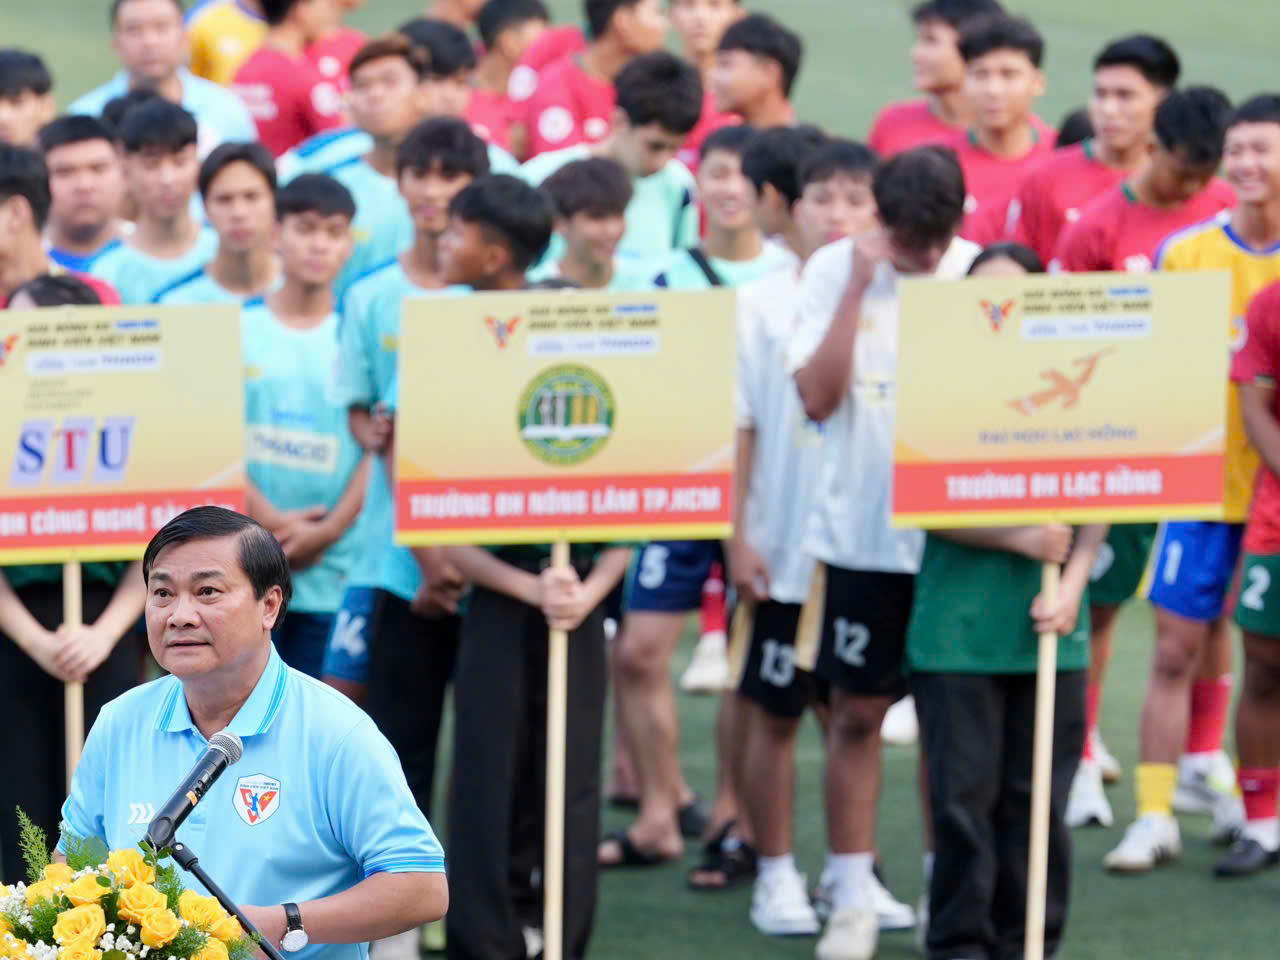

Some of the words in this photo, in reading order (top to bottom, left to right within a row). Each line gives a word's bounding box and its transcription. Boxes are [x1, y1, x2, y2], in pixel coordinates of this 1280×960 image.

[19, 427, 131, 475] STU
[1239, 564, 1271, 611] 2
[833, 616, 870, 668] 12
